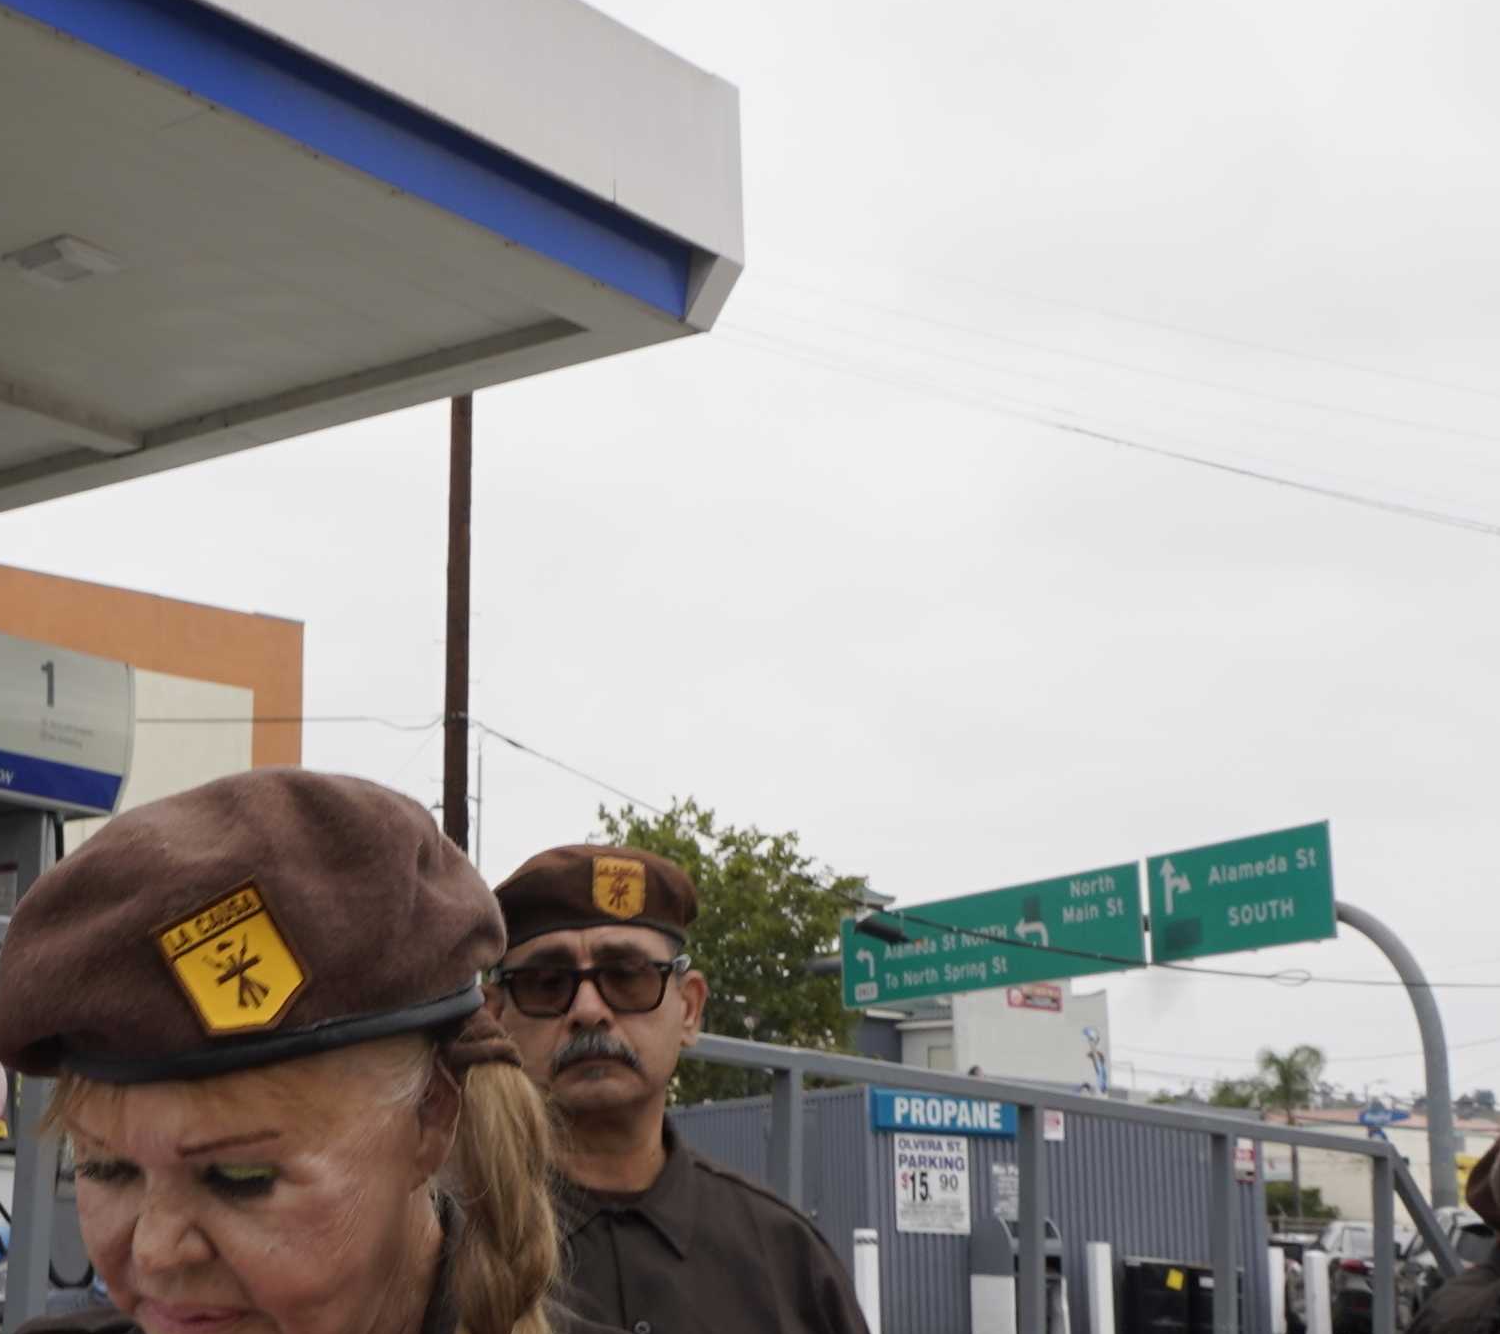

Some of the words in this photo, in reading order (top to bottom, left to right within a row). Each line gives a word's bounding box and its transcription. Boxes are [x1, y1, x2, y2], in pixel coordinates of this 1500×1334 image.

[40, 660, 55, 708] 1
[1207, 853, 1289, 886] Alameda
[1295, 847, 1318, 870] St
[1069, 874, 1117, 898] North
[1062, 905, 1102, 924] Main
[1106, 897, 1125, 917] St
[1227, 898, 1295, 927] SOUTH
[942, 933, 958, 952] St
[885, 971, 899, 990] To
[903, 965, 940, 987] North
[943, 961, 988, 984] Spring
[991, 956, 1008, 975] St
[894, 1095, 1003, 1131] PROPANE
[898, 1138, 944, 1153] OLVERA
[897, 1153, 965, 1172] PARKING
